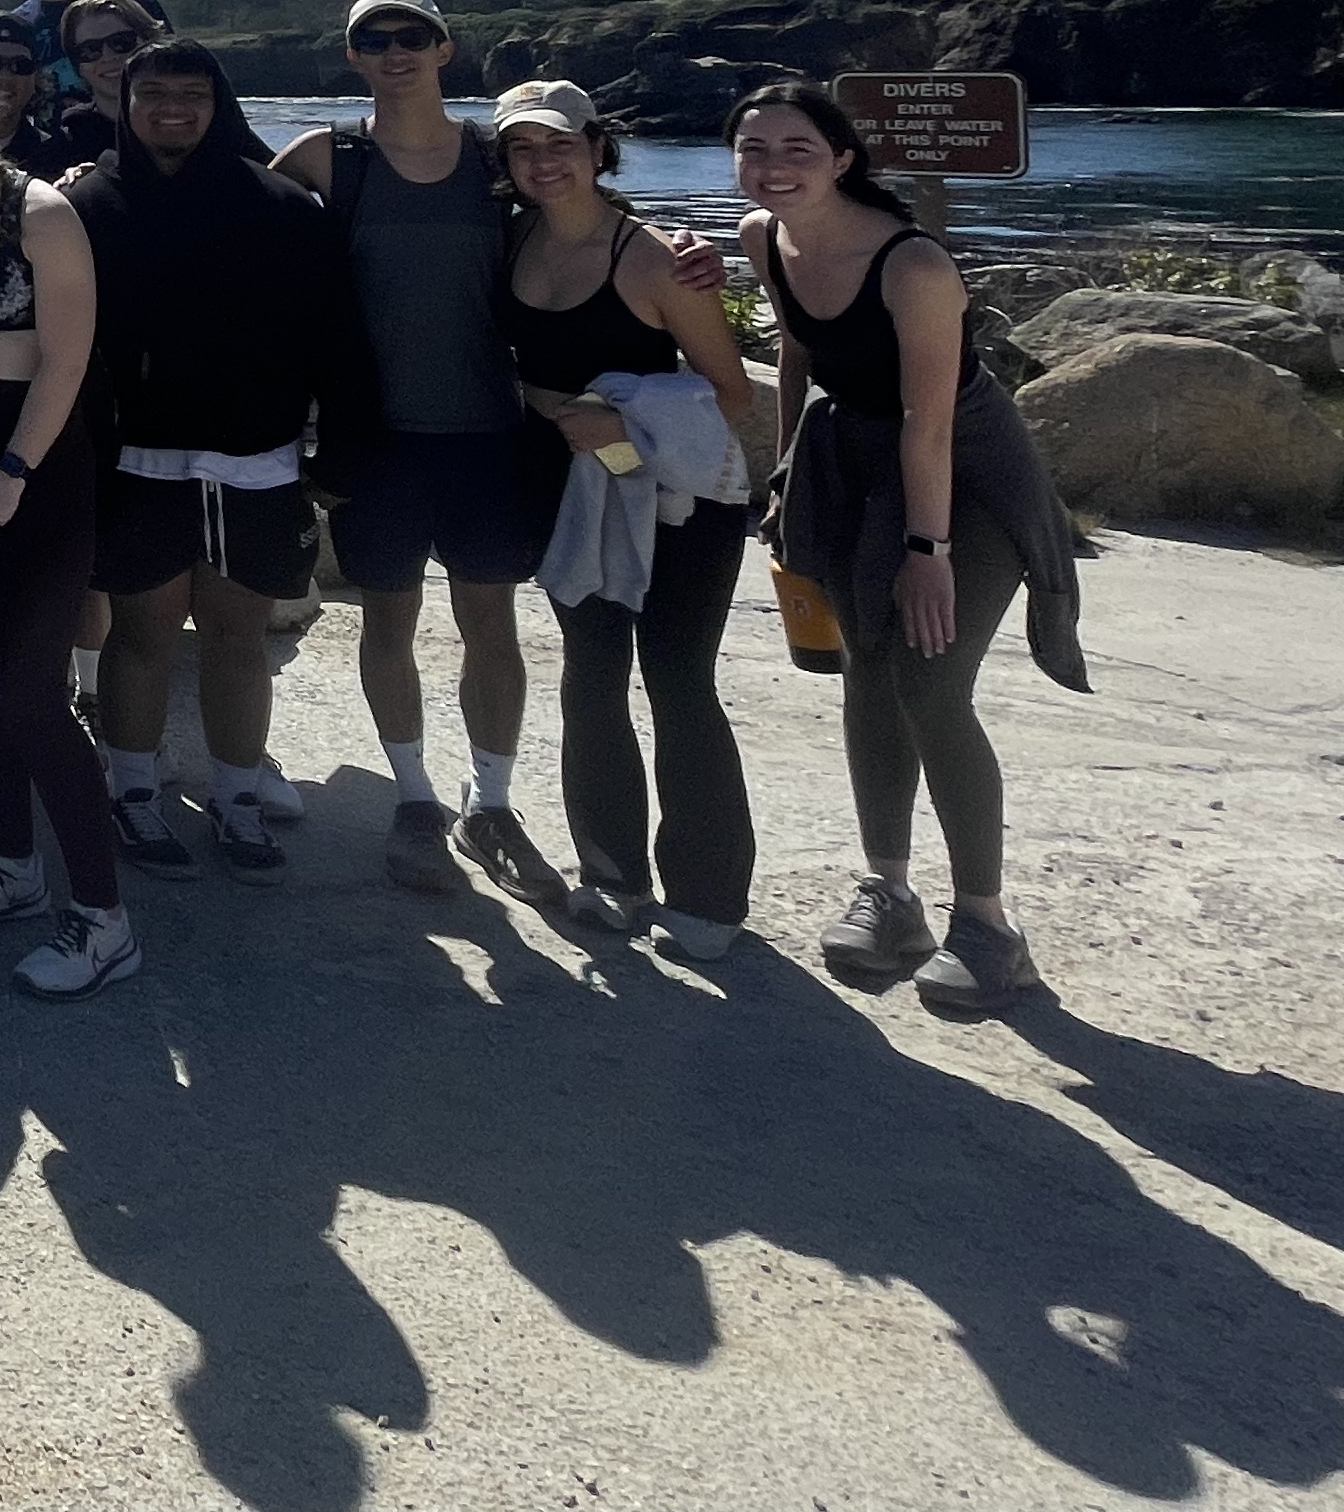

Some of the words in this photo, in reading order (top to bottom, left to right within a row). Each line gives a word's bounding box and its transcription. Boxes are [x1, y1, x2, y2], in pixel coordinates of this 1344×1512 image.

[883, 83, 966, 97] DIVERS
[897, 104, 954, 115] ENTER
[853, 119, 877, 130] OR
[885, 119, 937, 131] LEAVE
[945, 120, 1003, 131] WATER
[865, 135, 884, 145] AT
[895, 135, 931, 146] THIS
[939, 135, 991, 147] POINT
[905, 150, 950, 161] ONLY
